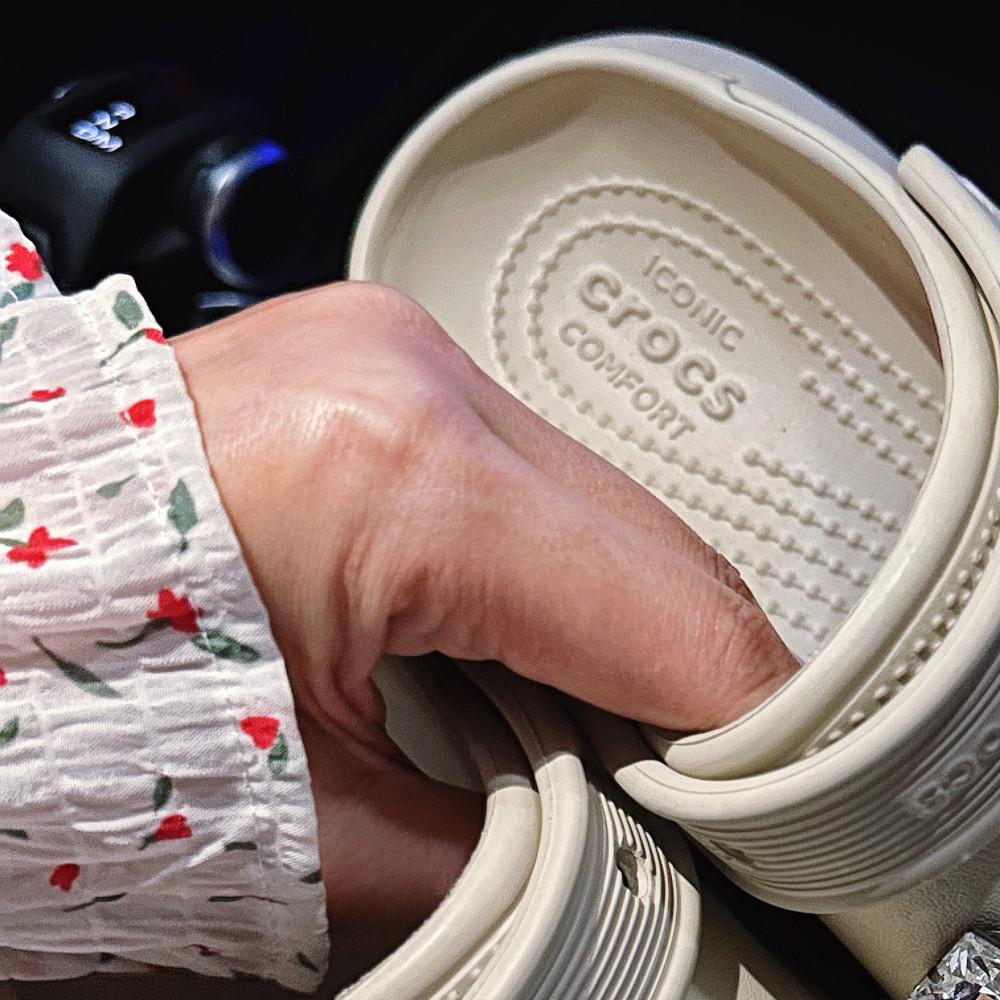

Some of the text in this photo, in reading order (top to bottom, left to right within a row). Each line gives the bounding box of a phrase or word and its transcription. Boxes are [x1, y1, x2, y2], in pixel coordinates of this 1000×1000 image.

[578, 268, 747, 422] crocs
[643, 254, 745, 352] ICONIC
[558, 319, 697, 440] COMFORT
